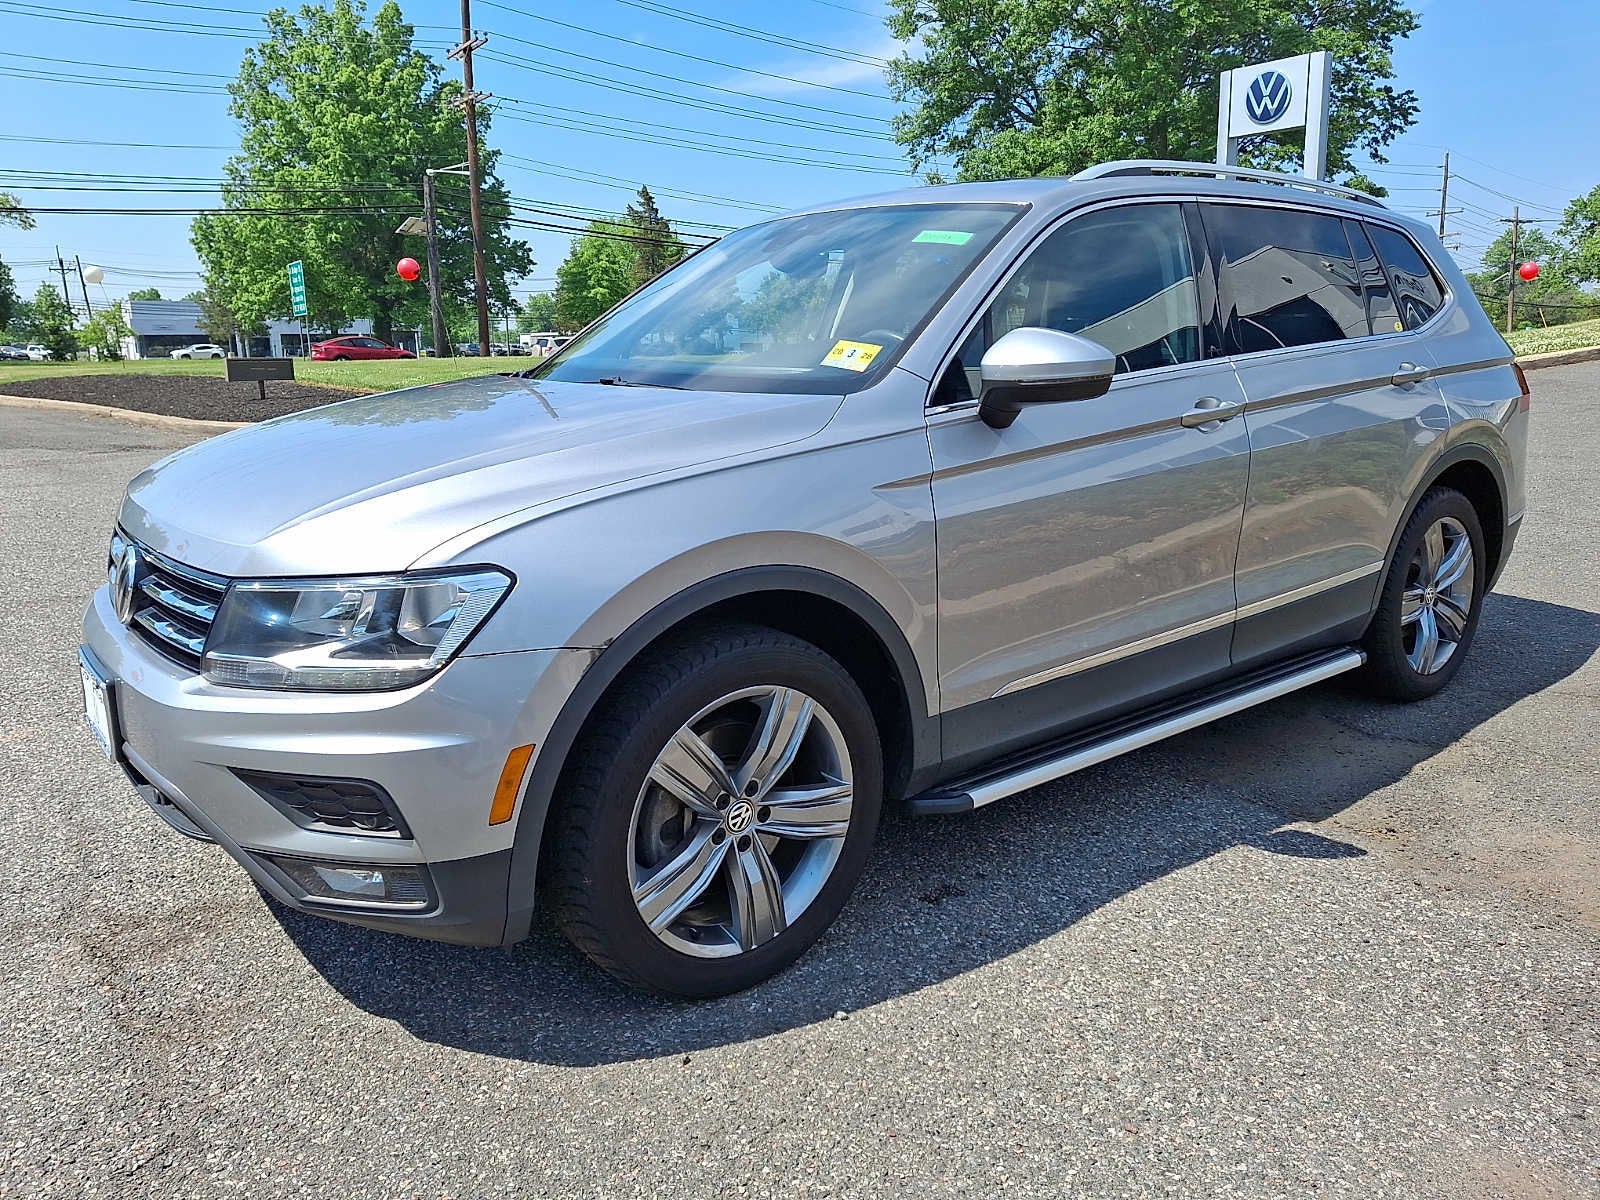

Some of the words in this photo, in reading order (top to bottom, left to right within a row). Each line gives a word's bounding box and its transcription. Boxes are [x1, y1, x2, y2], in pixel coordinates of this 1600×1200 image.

[1246, 71, 1292, 123] VW
[847, 349, 857, 358] 3
[728, 801, 753, 832] VW
